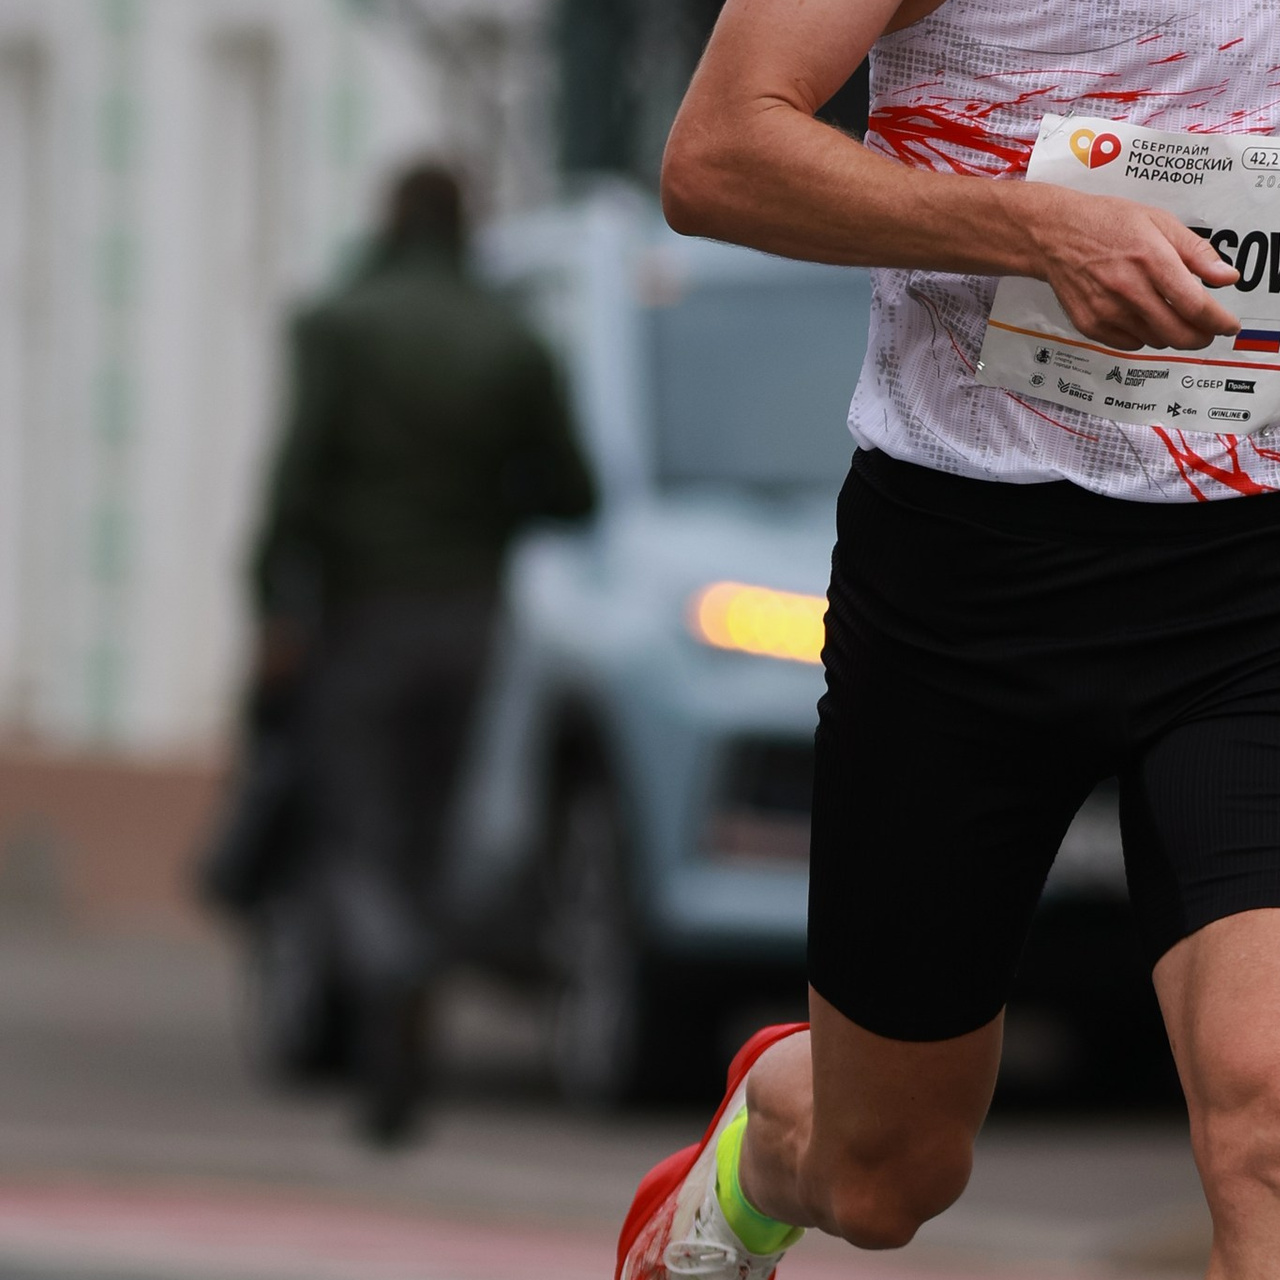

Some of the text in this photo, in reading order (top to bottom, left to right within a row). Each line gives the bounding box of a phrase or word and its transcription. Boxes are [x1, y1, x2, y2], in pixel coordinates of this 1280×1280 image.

[1132, 138, 1209, 155] СБЕРПРАЙМ
[1128, 150, 1233, 171] МОСКОВСКИЙ
[1250, 152, 1278, 167] 42,2
[1125, 165, 1204, 184] МАРАФОН
[1127, 368, 1169, 379] МОСКОВСКИЙ
[1124, 377, 1146, 387] СПОРТ
[1197, 380, 1251, 391] СБЕР Прайм
[1069, 389, 1093, 401] BRICS
[1211, 408, 1242, 418] WINLINE
